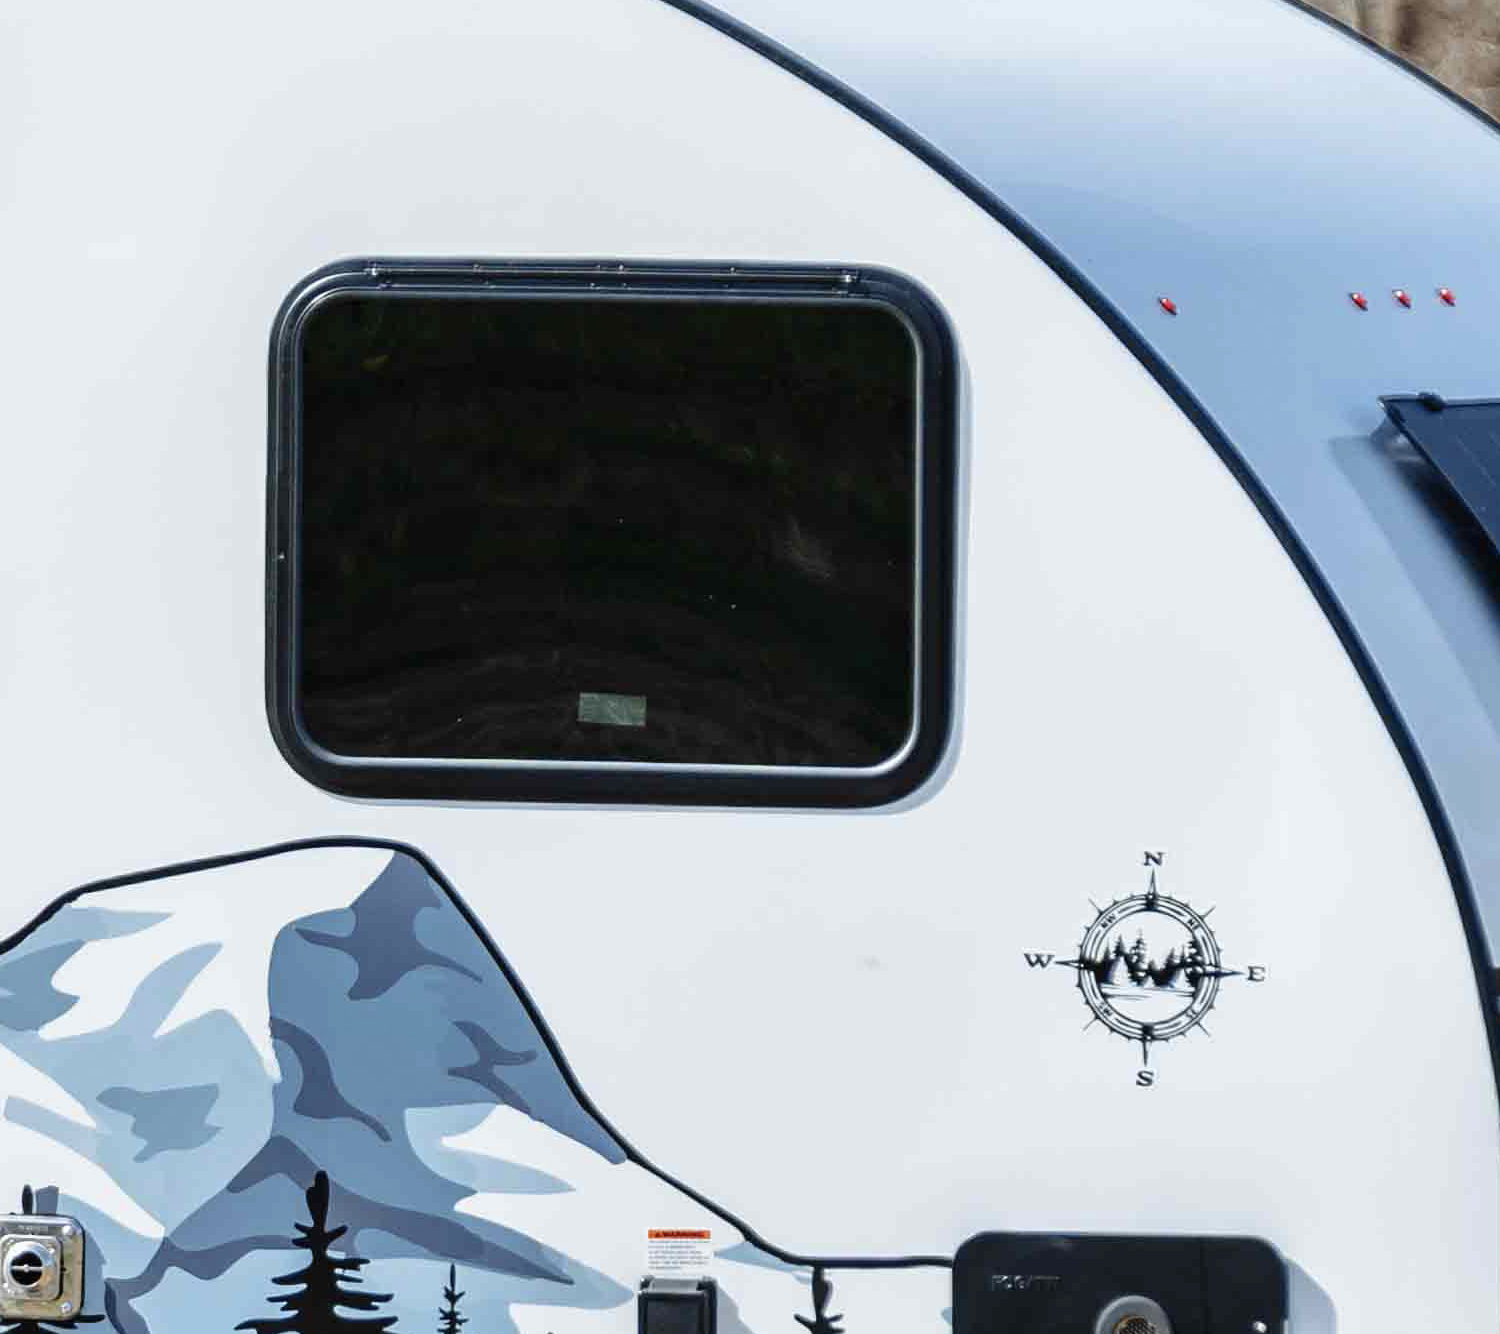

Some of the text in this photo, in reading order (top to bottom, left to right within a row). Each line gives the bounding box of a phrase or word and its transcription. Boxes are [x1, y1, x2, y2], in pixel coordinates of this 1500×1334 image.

[1142, 850, 1166, 867] N
[1023, 953, 1055, 969] W
[1246, 966, 1266, 983] E
[1135, 1070, 1155, 1088] S
